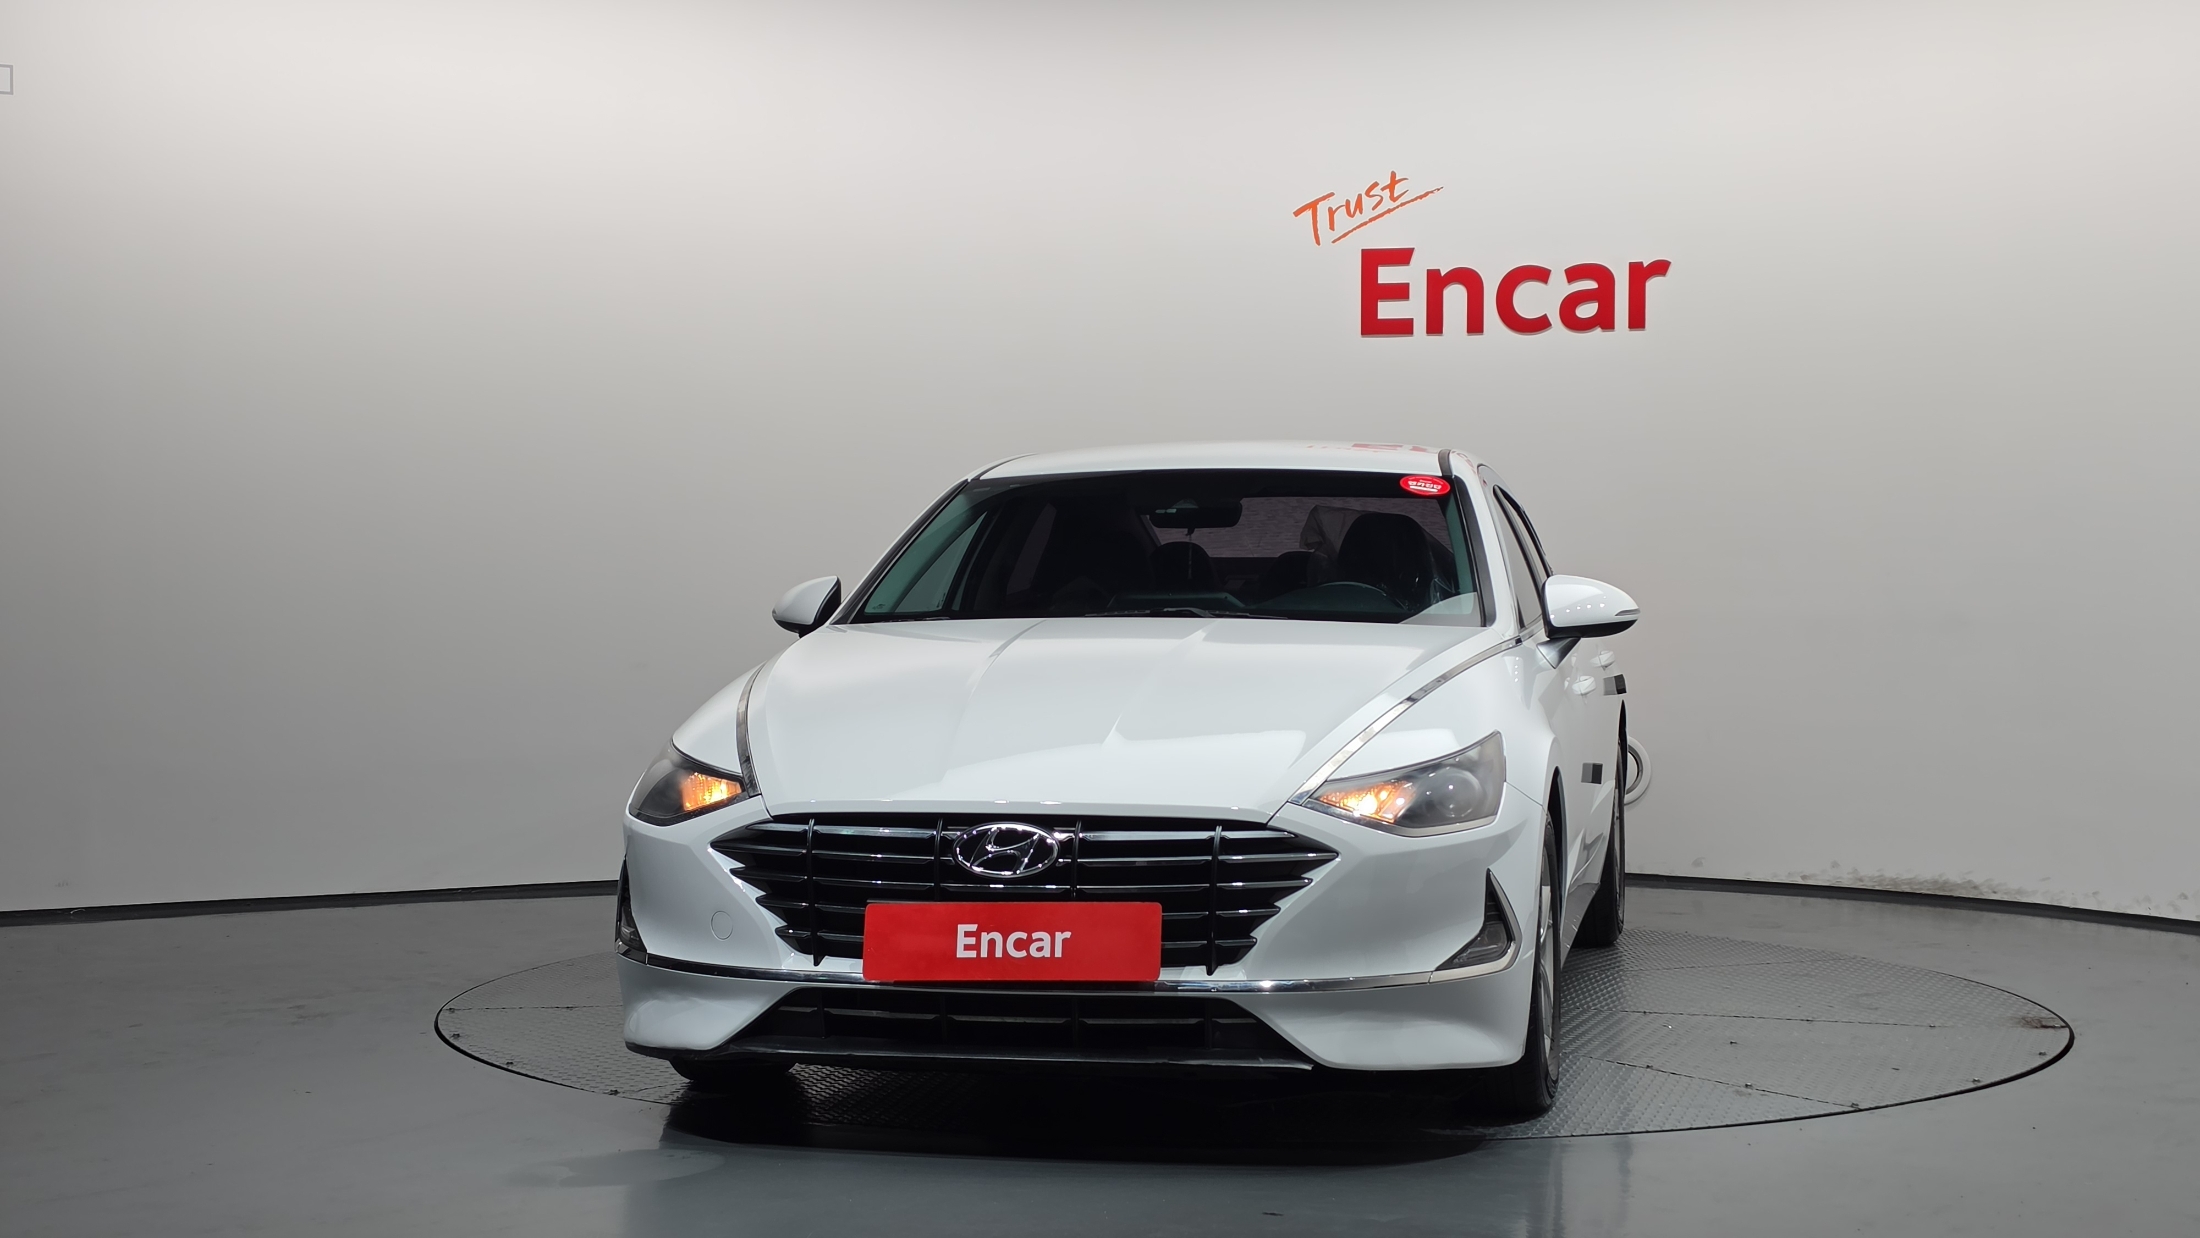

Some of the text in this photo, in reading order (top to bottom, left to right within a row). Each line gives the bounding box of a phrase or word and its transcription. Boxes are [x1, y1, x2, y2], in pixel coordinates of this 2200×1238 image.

[1292, 171, 1409, 247] Trust
[1360, 247, 1671, 337] Encar
[956, 923, 1072, 959] Encar
